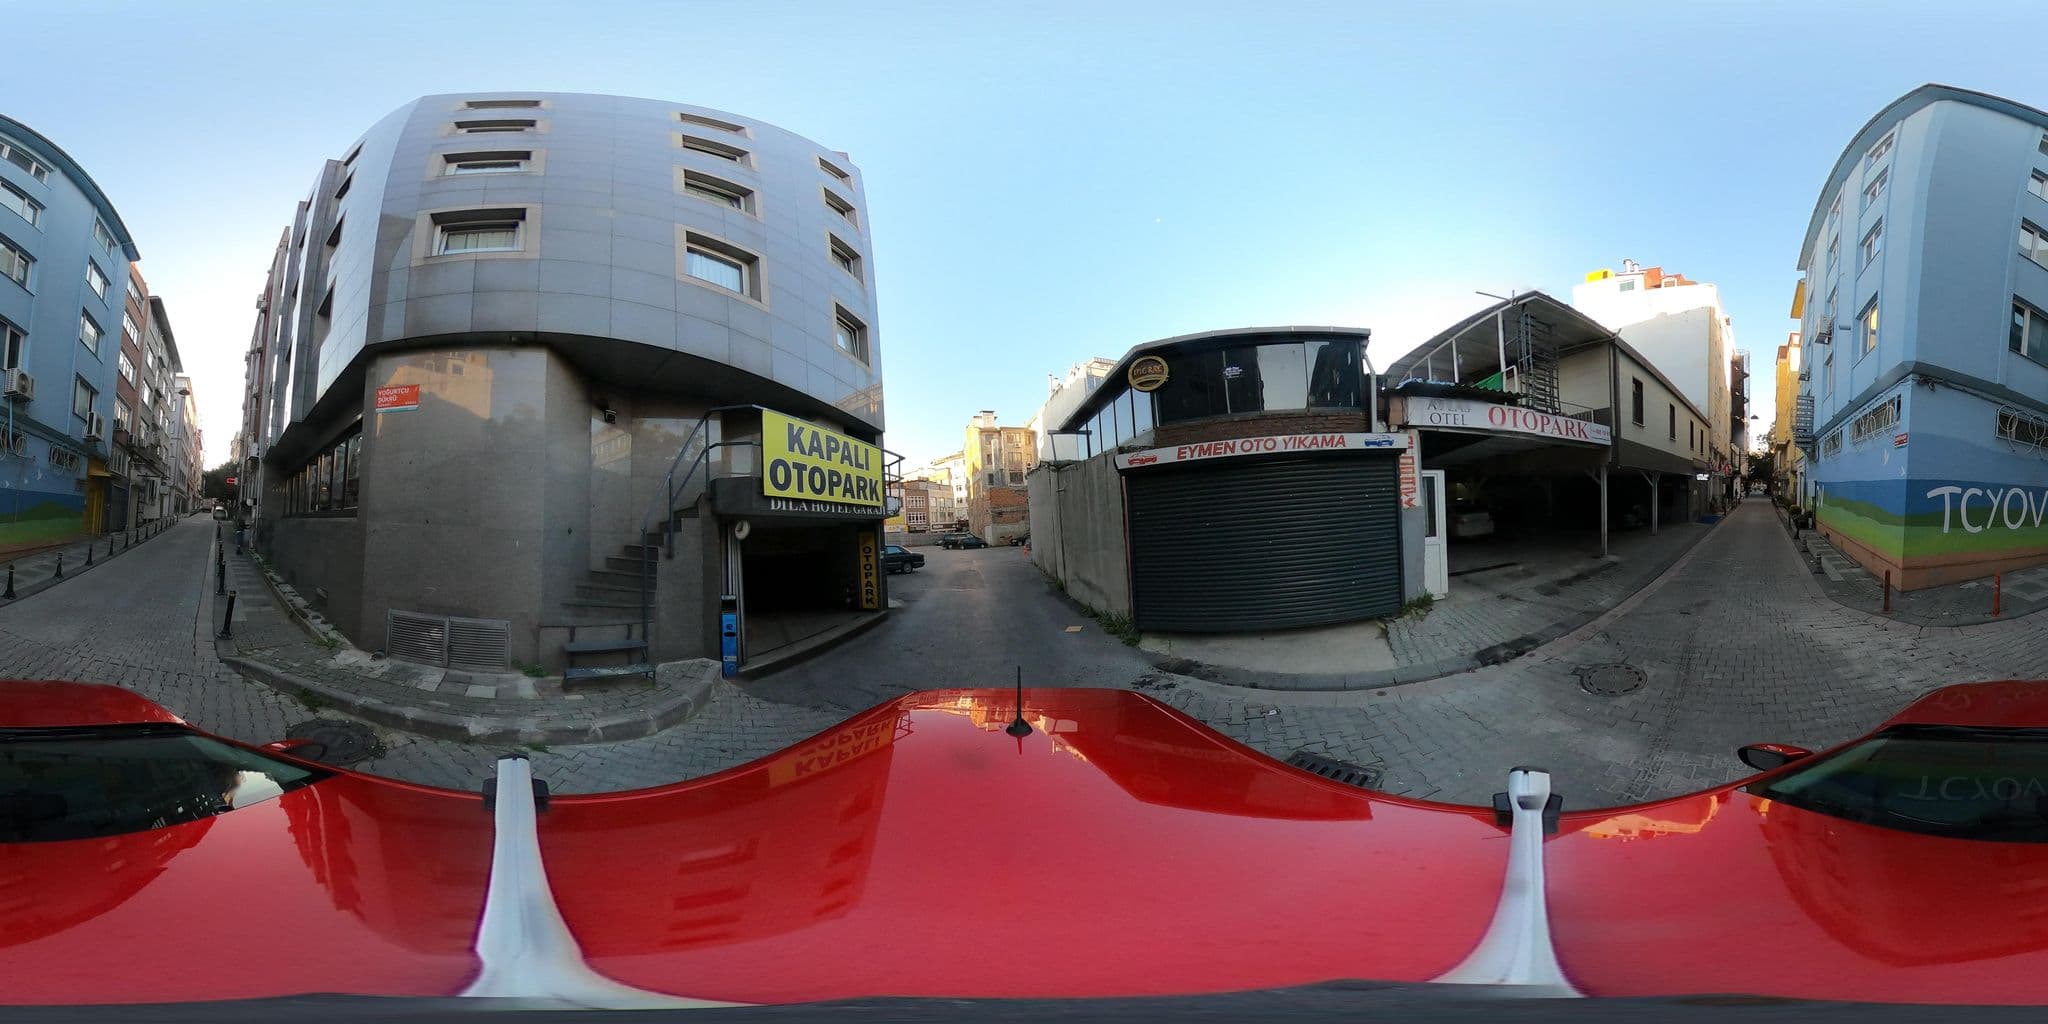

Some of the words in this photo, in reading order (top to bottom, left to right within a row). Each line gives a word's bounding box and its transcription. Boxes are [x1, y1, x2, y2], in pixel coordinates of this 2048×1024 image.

[1429, 412, 1469, 425] OTEL
[1488, 406, 1589, 440] OTOPARK
[787, 422, 870, 471] KAPALI
[1177, 441, 1236, 460] EYMEN
[1240, 436, 1278, 453] OTO
[1282, 434, 1347, 450] YIKAMA
[769, 458, 881, 502] OTOPARK
[1926, 486, 2048, 534] TCYOV
[863, 545, 874, 605] OTOPARK
